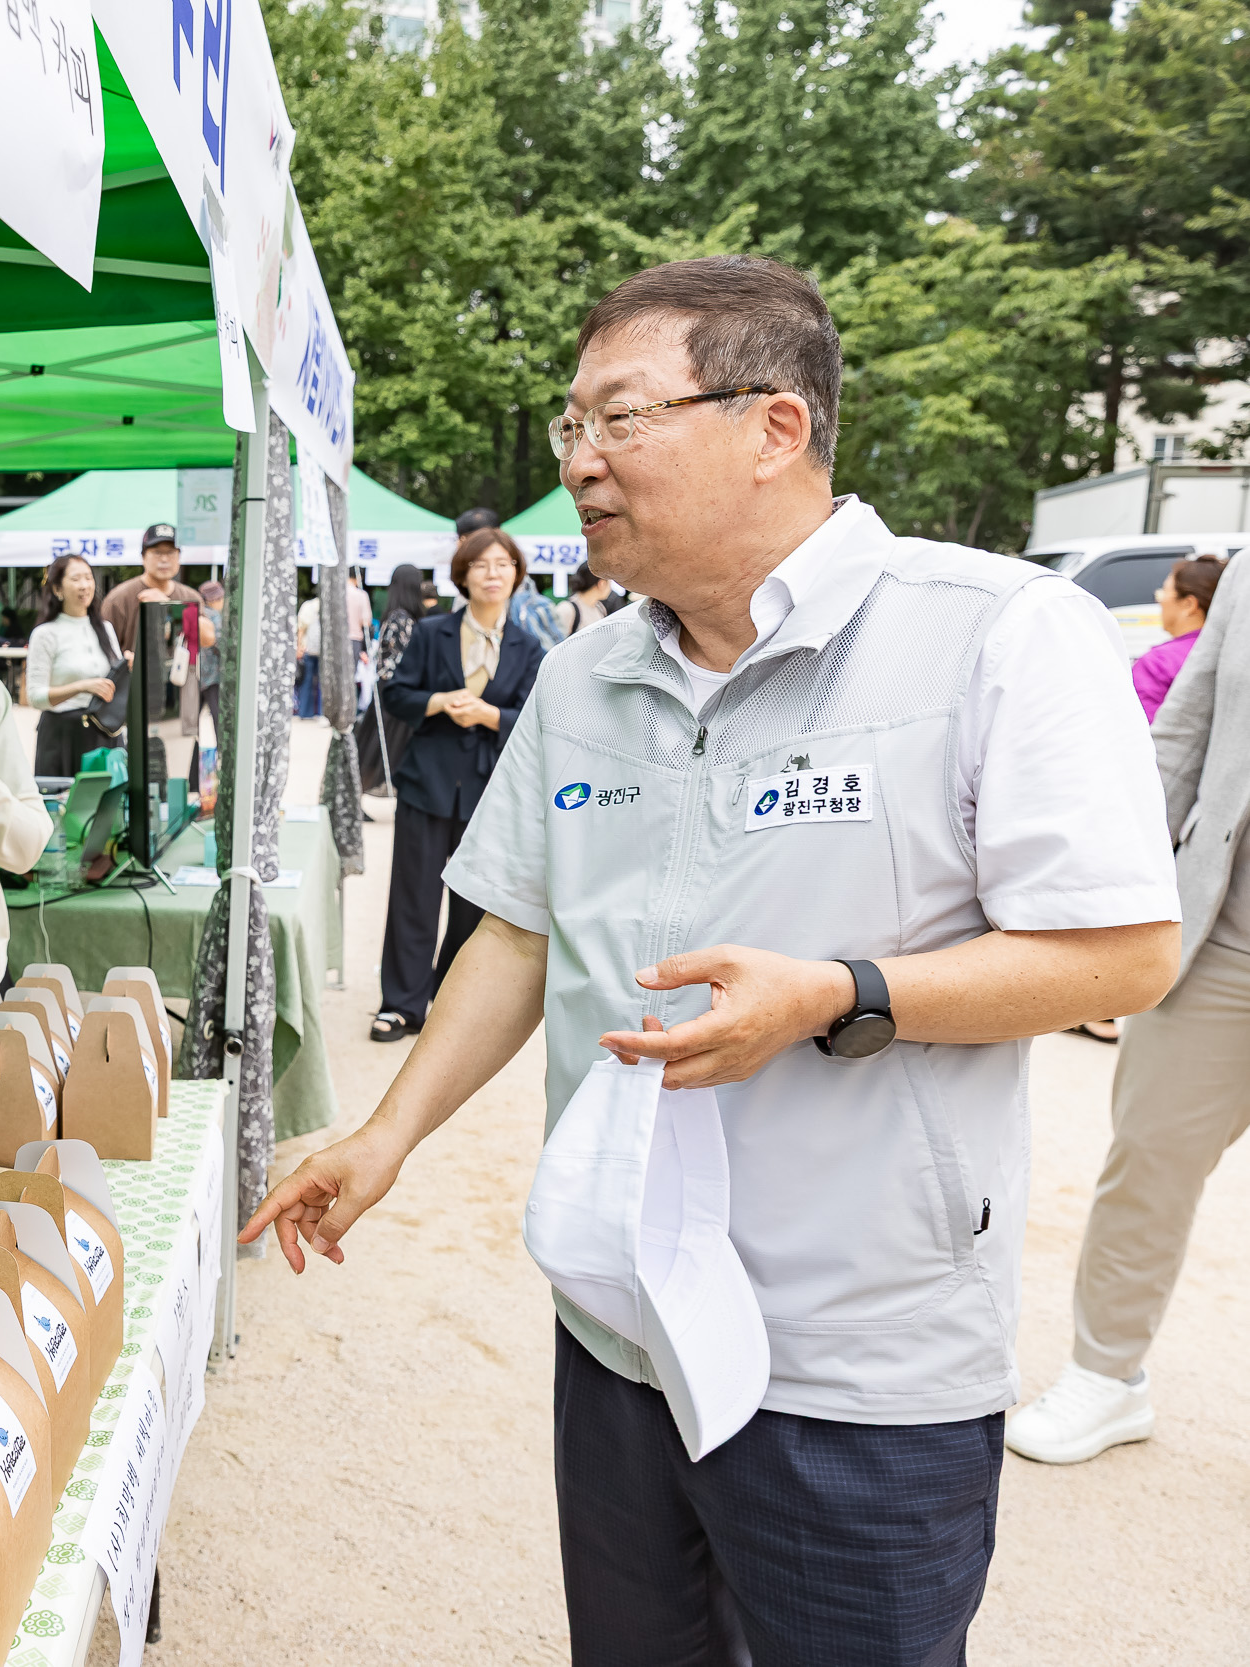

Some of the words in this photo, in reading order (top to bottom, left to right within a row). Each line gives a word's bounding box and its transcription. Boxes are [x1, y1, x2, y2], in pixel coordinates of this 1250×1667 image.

[533, 545, 581, 565] 자양
[595, 786, 642, 807] 광진구
[782, 797, 862, 817] 광진구청장
